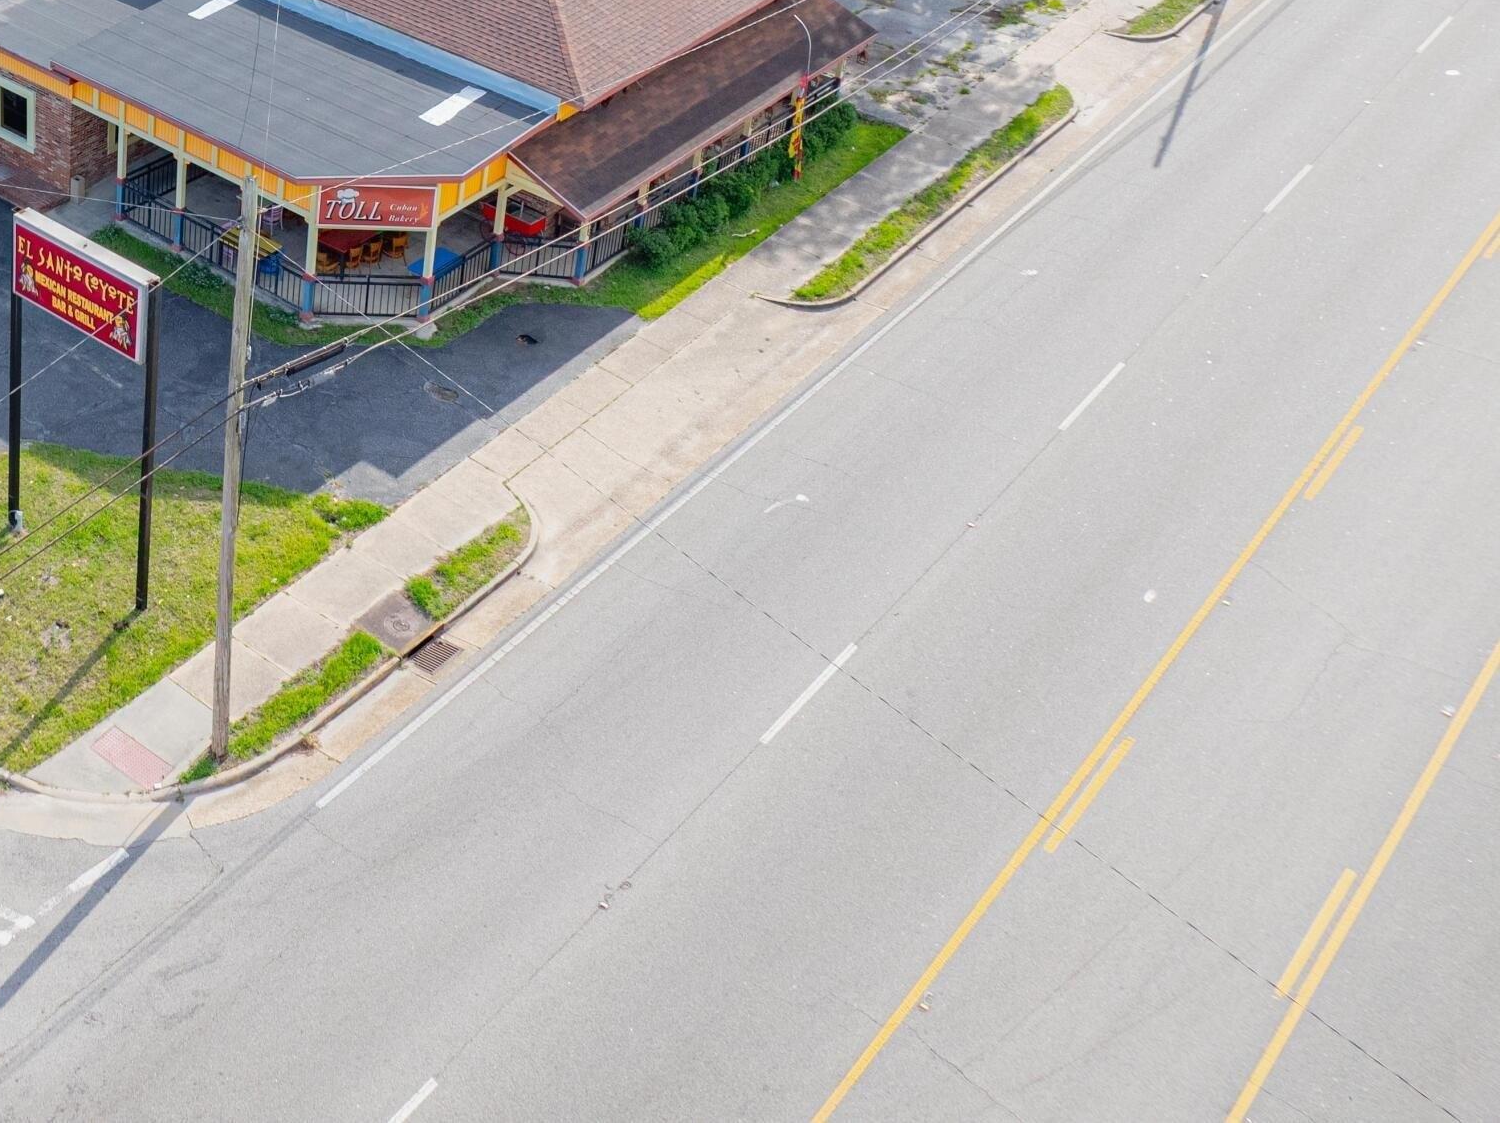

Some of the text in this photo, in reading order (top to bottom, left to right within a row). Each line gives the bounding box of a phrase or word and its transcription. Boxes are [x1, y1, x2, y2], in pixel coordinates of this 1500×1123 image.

[324, 199, 418, 221] TOLL Cuban
[388, 215, 420, 225] Bakery
[18, 235, 33, 259] EL
[37, 247, 83, 283] SANTO
[35, 271, 114, 325] MEXICAN RESTAURANT
[51, 295, 96, 331] BAR & GRILL
